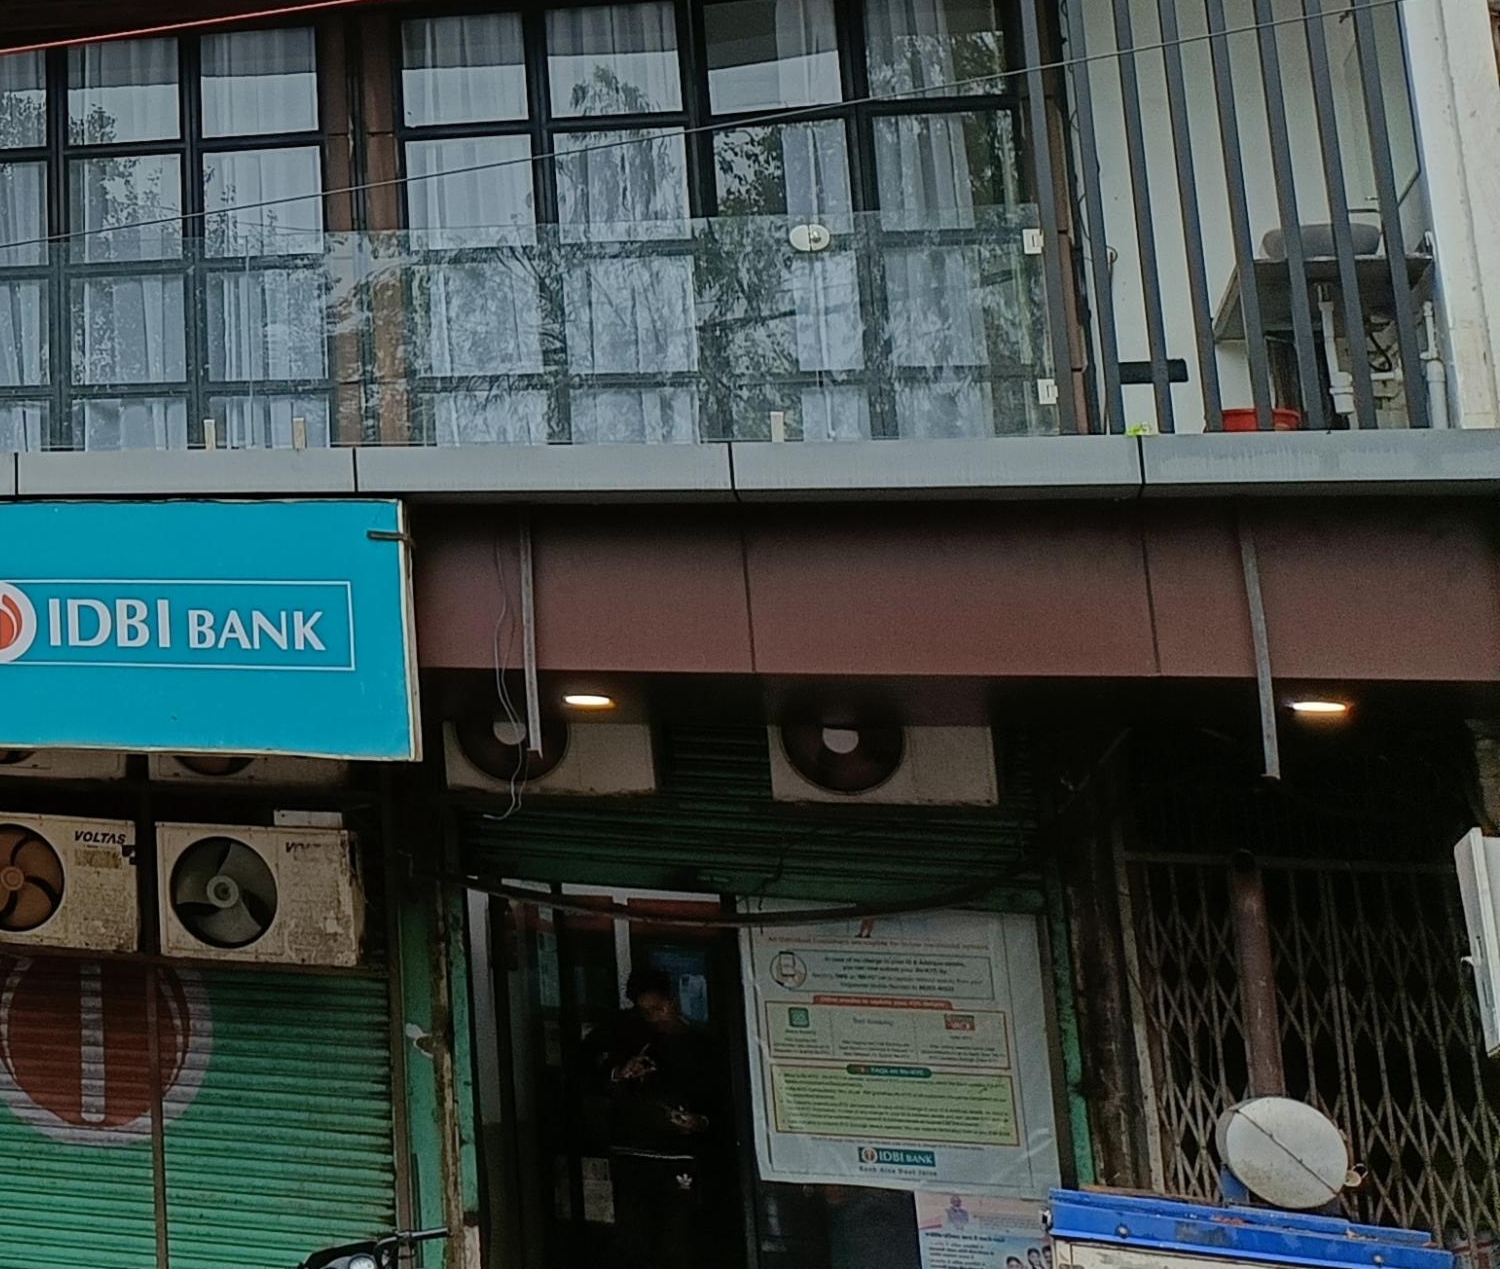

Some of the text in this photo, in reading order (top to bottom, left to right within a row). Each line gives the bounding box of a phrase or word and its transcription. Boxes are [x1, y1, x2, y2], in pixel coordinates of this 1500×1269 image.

[48, 598, 327, 651] IDBI BANK
[74, 830, 127, 845] VOLTAS
[878, 1150, 933, 1165] IDBI BANK
